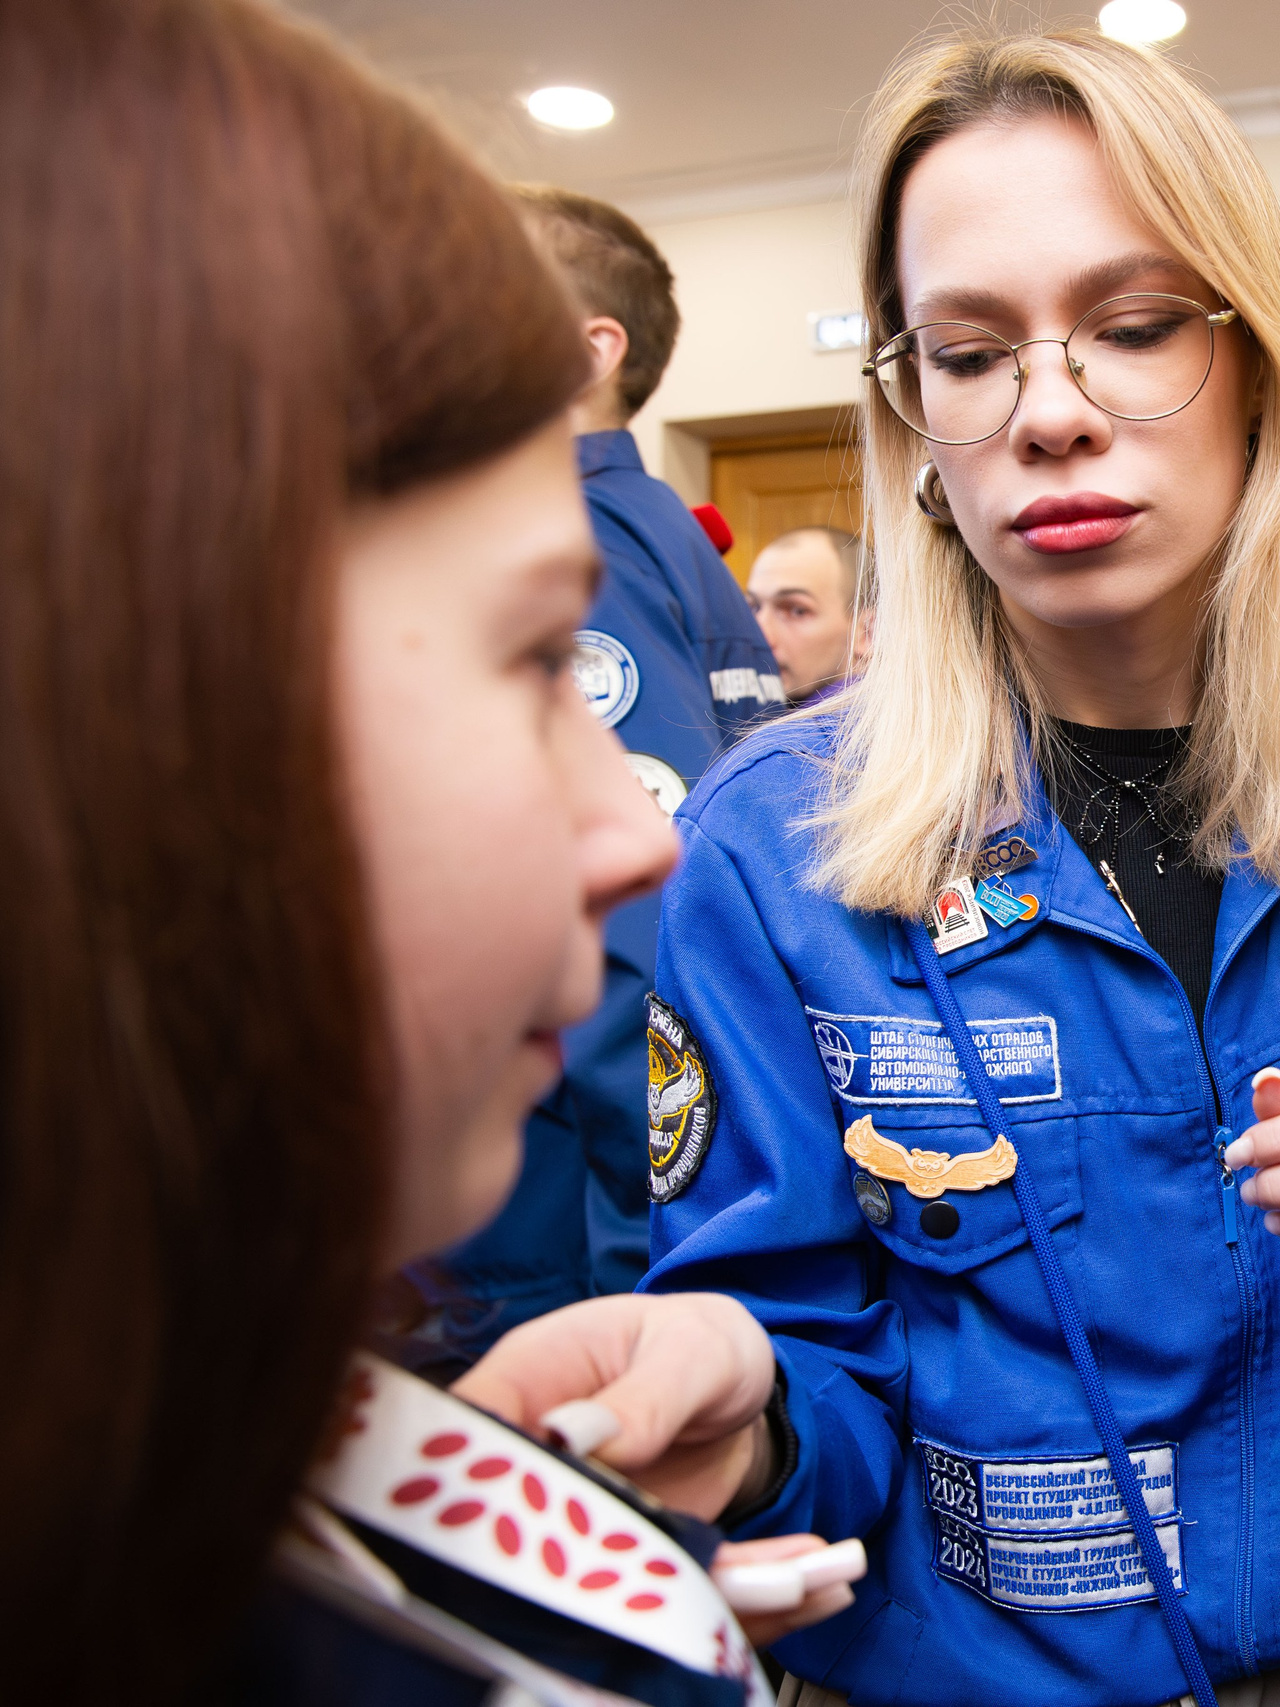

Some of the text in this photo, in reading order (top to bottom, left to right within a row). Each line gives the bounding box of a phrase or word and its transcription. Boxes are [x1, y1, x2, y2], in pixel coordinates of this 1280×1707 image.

[870, 1031, 904, 1045] ШТАБ
[991, 1031, 1044, 1047] ОТРЯДОВ
[870, 1046, 938, 1062] СИБИРСКОГО
[870, 1076, 956, 1092] УНИВЕРСИТЕТА
[986, 1468, 1086, 1489] ВСЕРОССИЙСКИЙ
[930, 1472, 978, 1518] 2023
[986, 1489, 1030, 1505] ПРОЕКТ
[986, 1504, 1073, 1521] ПРОВОДНИКОВ
[940, 1536, 986, 1587] 2024
[990, 1547, 1081, 1566] ВСЕРОССИЙСКИЙ
[991, 1562, 1029, 1580] ПРОЕКТ
[1032, 1560, 1118, 1582] СТУДЕНЧЕСКИХ
[992, 1576, 1069, 1596] ПРОВОДНИКОВ
